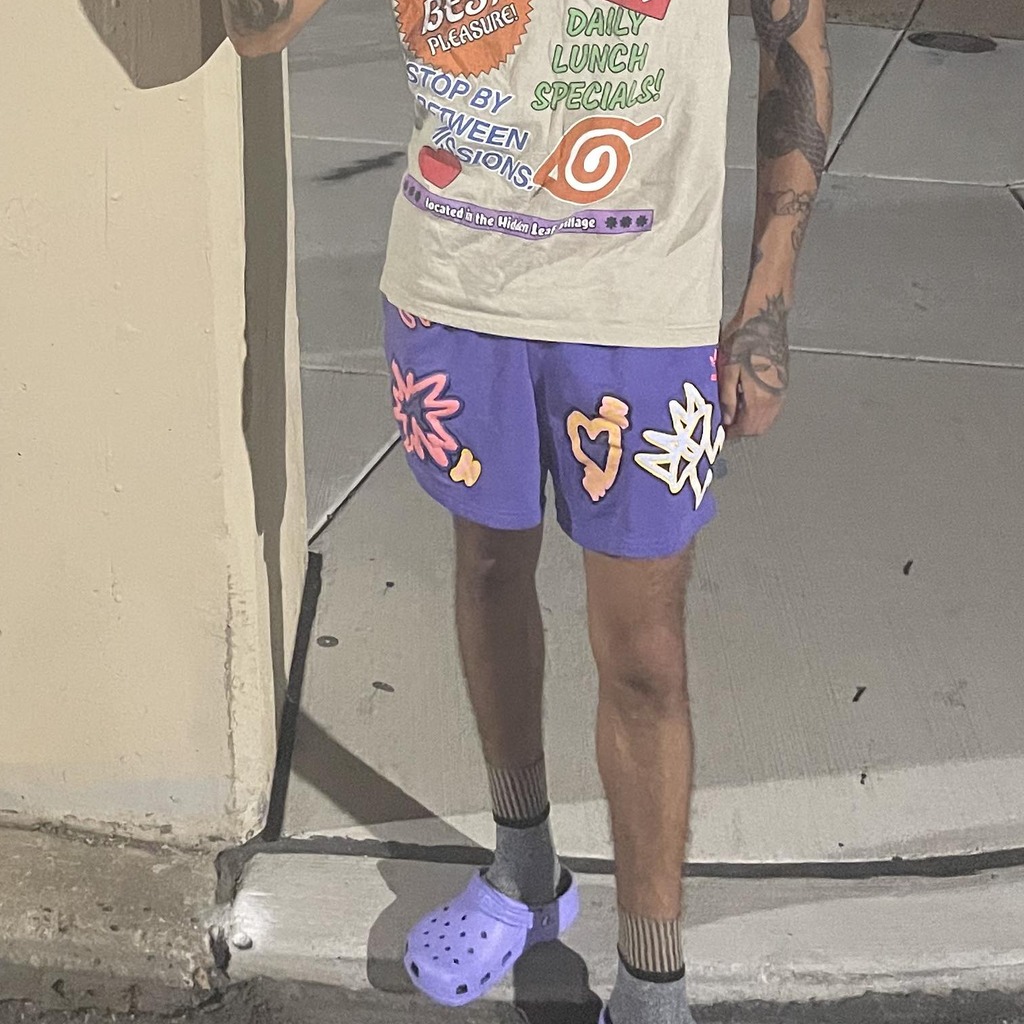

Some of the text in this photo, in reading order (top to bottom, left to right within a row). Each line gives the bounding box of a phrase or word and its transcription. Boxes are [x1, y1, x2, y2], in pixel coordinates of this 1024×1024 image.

[427, 2, 520, 56] PLEASURE!
[566, 7, 647, 37] DAILY
[551, 42, 649, 75] LUNCH
[406, 63, 513, 114] STOP BY
[531, 68, 666, 112] SPECIALS!
[475, 212, 495, 227] the
[531, 223, 557, 237] Leaf
[558, 217, 597, 231] illage
